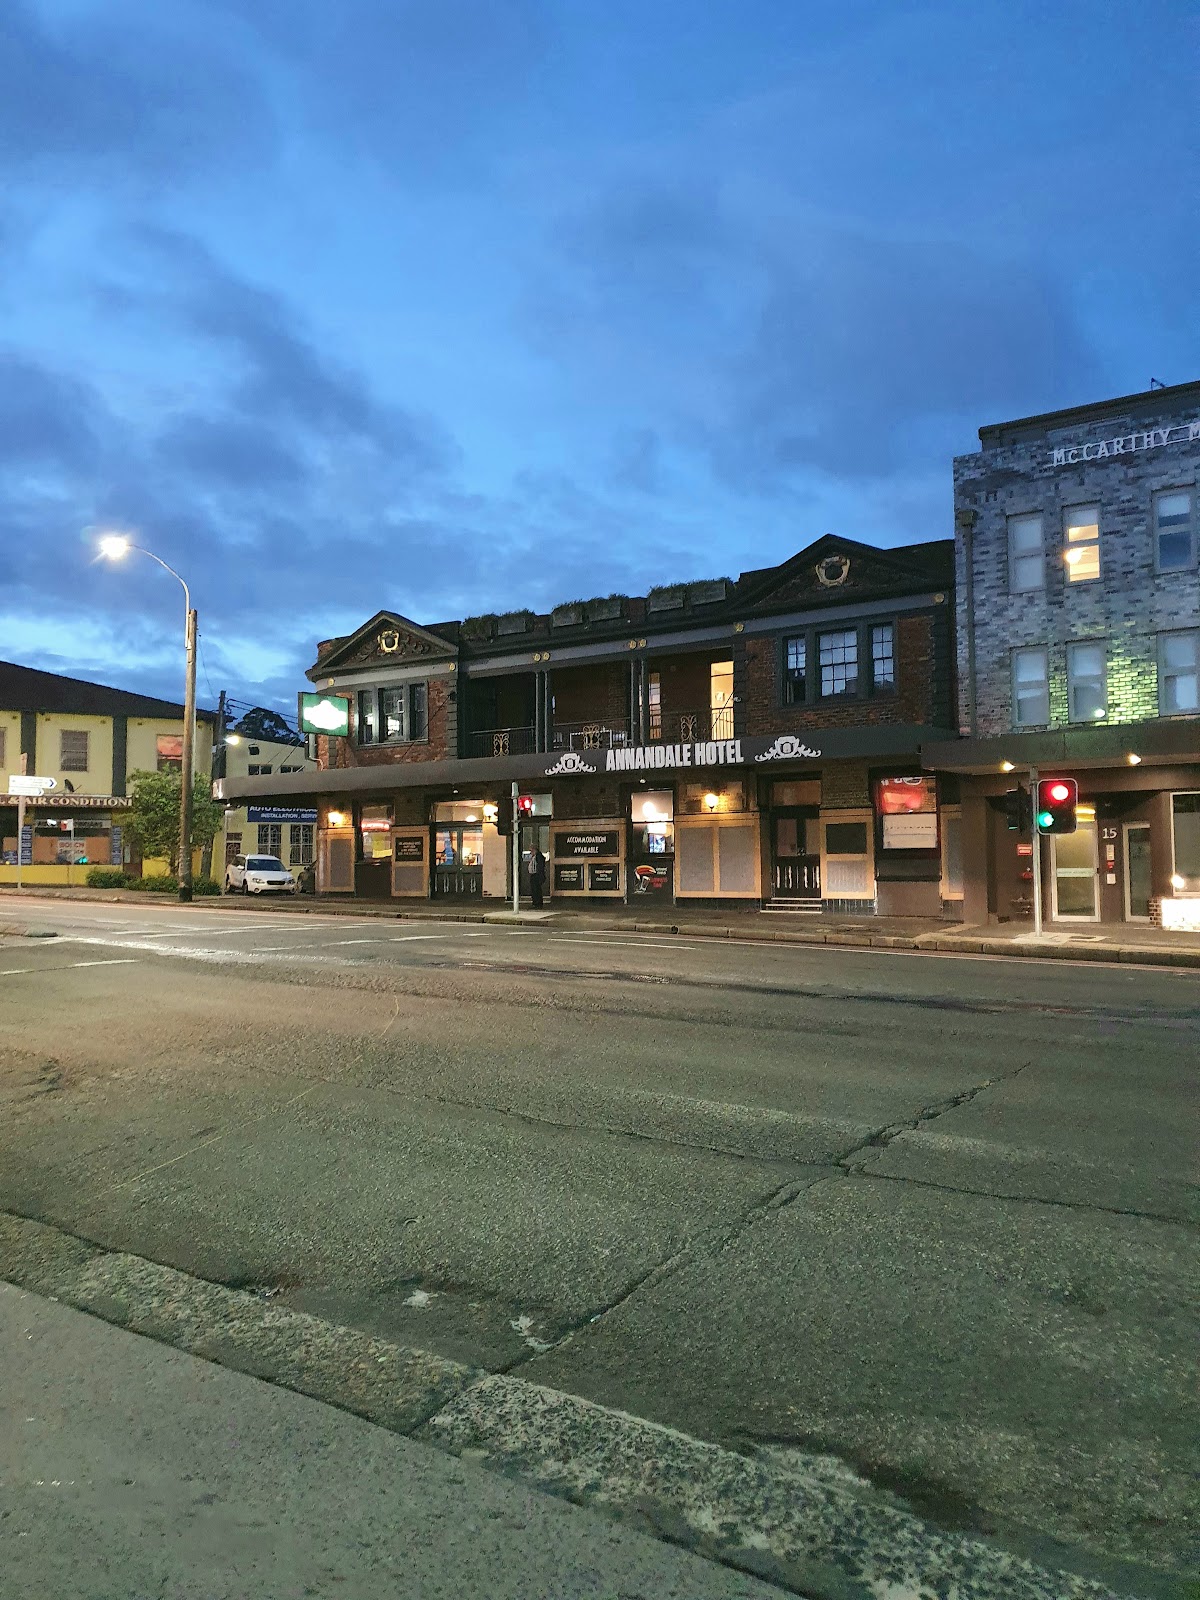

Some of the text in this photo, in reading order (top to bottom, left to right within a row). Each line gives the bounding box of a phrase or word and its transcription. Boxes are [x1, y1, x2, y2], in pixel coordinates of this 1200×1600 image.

[1053, 429, 1170, 467] McCARTHY
[606, 740, 744, 771] ANNANDALE HOTEL
[1102, 827, 1118, 839] 15
[573, 846, 599, 854] AVAILABLE
